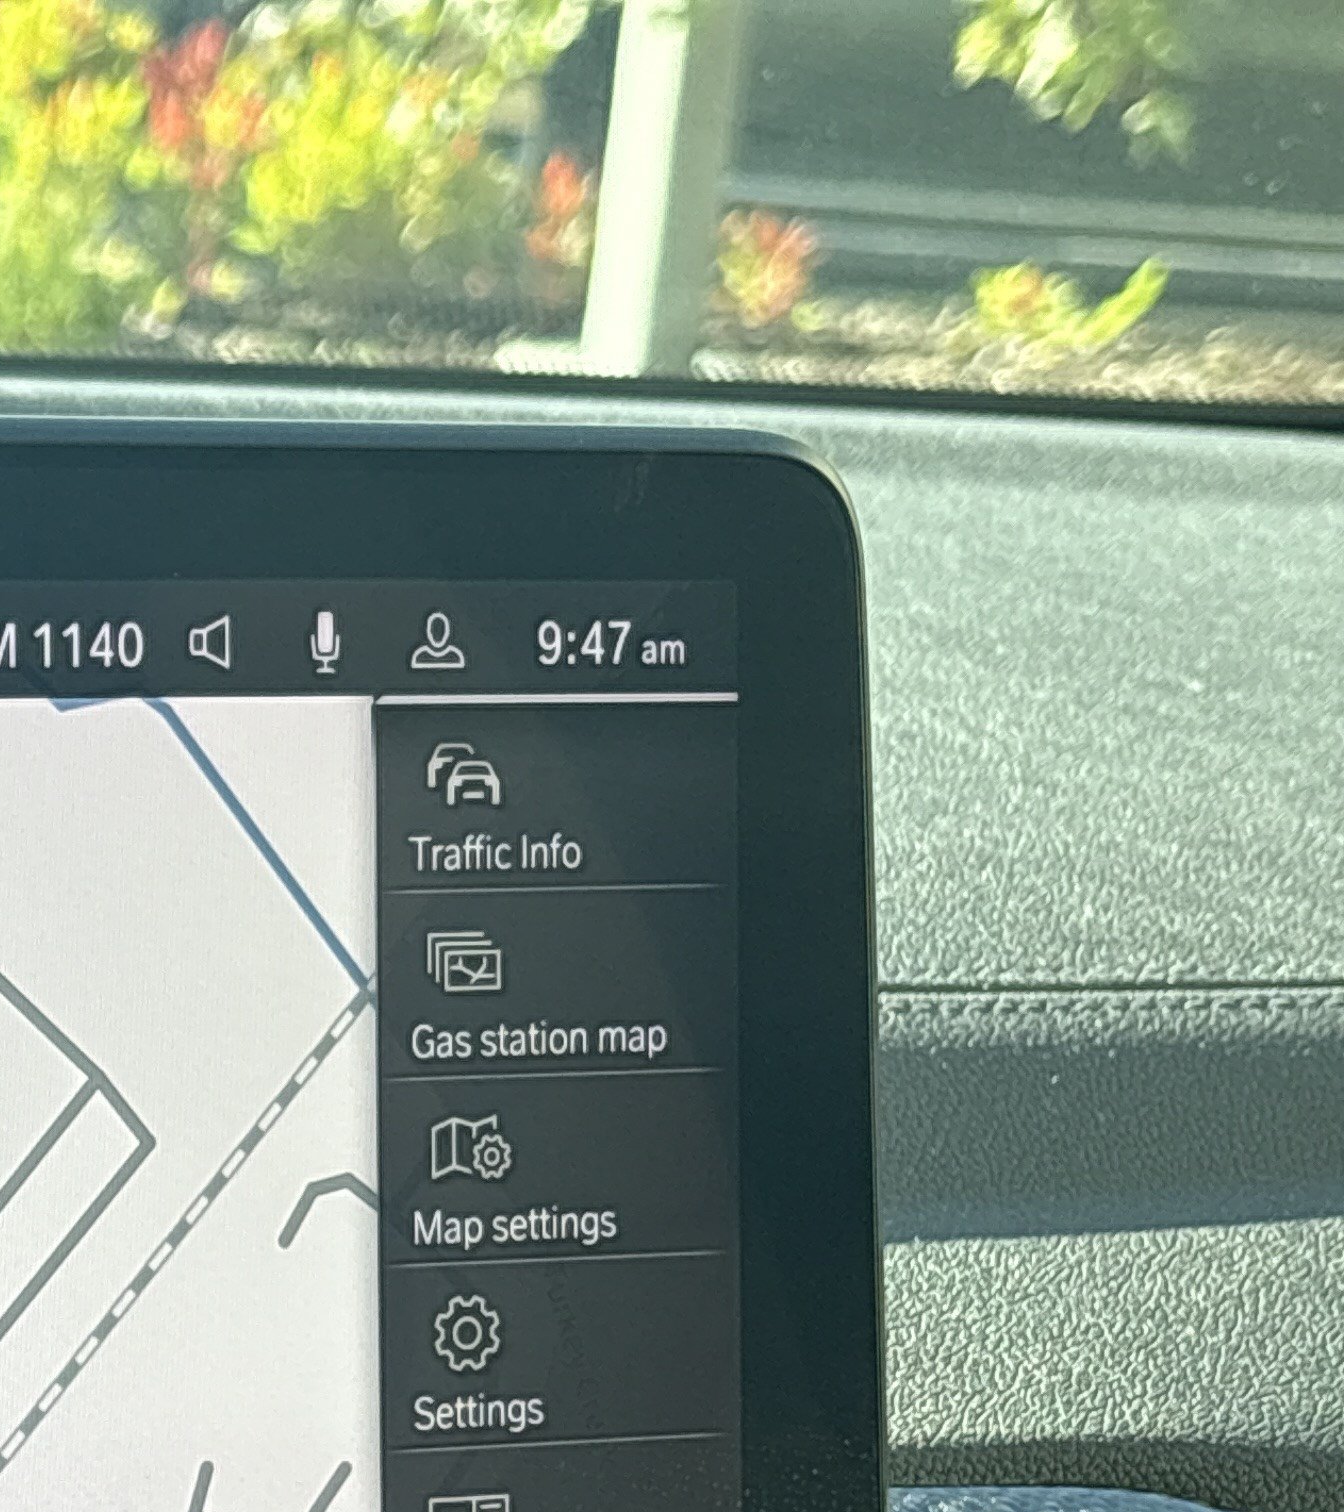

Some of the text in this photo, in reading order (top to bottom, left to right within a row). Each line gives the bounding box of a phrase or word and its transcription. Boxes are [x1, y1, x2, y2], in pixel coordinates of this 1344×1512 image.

[33, 621, 144, 668] 1140
[538, 620, 685, 665] 9:47 am
[408, 832, 581, 871] Traffic Info
[412, 1020, 668, 1059] Gas station map
[414, 1205, 617, 1251] Map settings
[414, 1392, 544, 1433] Settings
